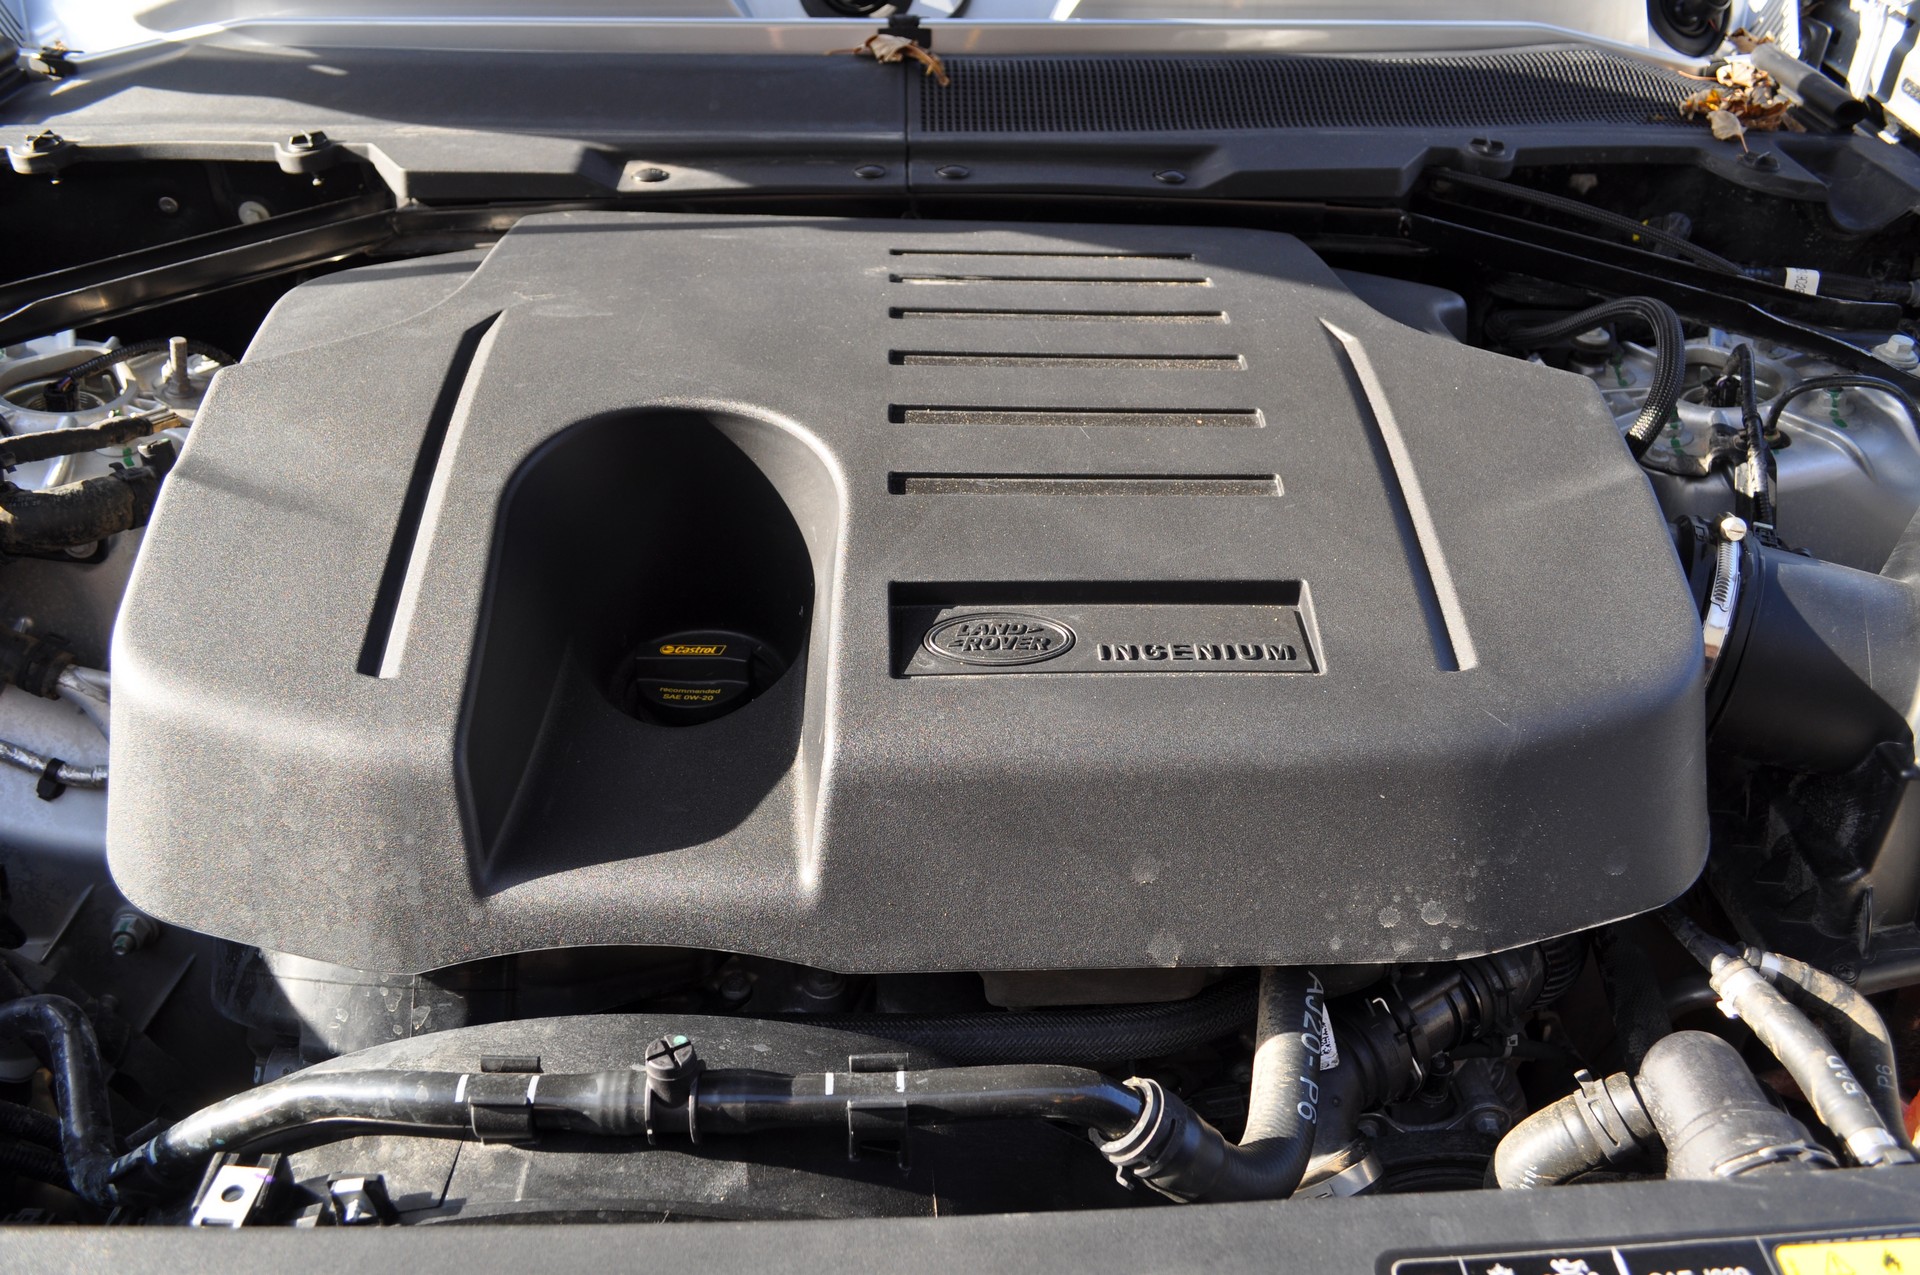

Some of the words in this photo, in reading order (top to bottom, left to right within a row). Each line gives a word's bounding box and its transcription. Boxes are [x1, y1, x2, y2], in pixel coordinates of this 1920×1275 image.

[956, 623, 1027, 636] LAND
[674, 645, 716, 654] Castrol
[962, 636, 1051, 651] ROVER
[1097, 643, 1297, 661] INGENIUM
